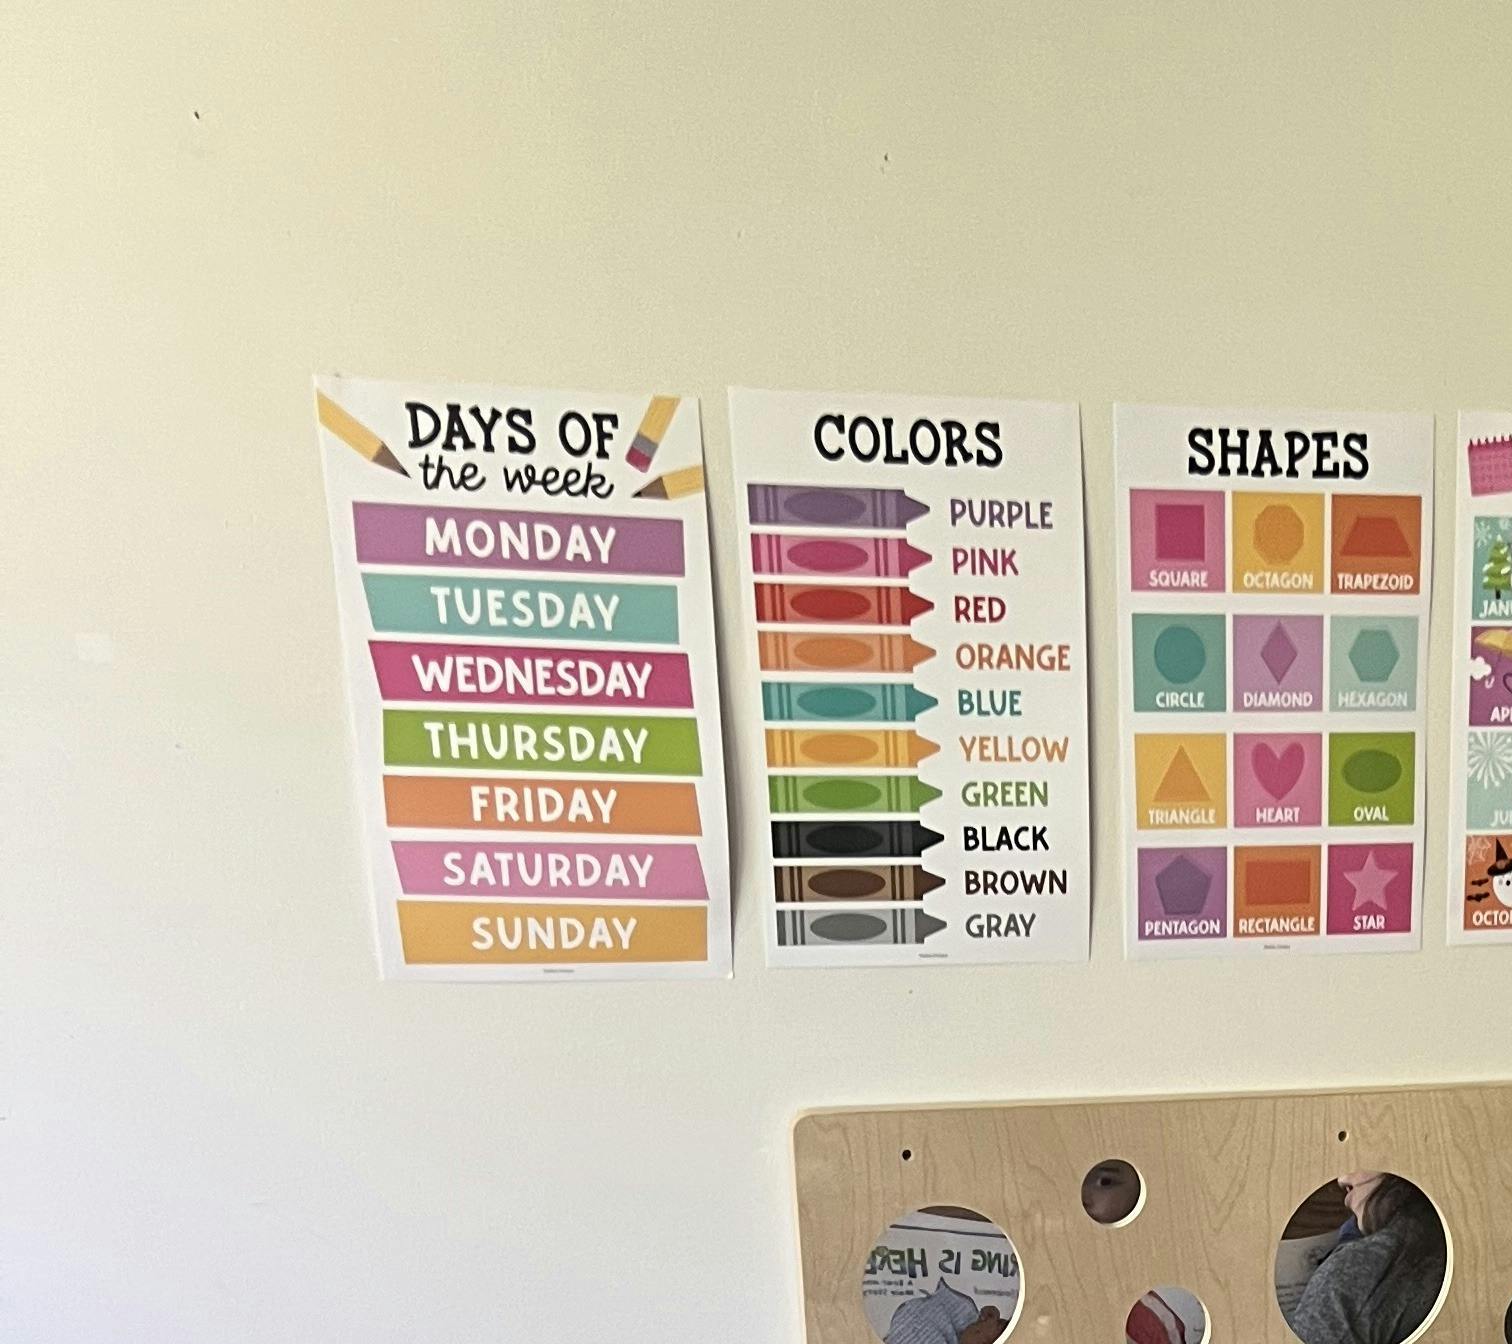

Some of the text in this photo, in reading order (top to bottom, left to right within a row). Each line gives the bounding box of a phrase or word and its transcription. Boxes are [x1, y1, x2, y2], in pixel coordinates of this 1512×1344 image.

[405, 402, 618, 459] DAYS OF
[814, 414, 1003, 468] COLORS
[1187, 428, 1369, 479] SHAPES
[419, 455, 614, 498] the week
[951, 499, 1053, 530] PURPLE
[425, 518, 616, 564] MONDAY
[952, 547, 1019, 576] PINK
[1149, 570, 1208, 588] SQUARE
[1243, 571, 1313, 590] OCTAGON
[1337, 573, 1414, 592] TRAPEZOID
[431, 586, 619, 632] TUESDAY
[954, 596, 1006, 624] RED
[956, 644, 1071, 672] ORANGE
[412, 654, 652, 699] WEDNESDAY
[958, 690, 1022, 717] BLUE
[1156, 692, 1205, 709] CIRCLE
[1243, 691, 1313, 708] DIAMOND
[1338, 691, 1407, 708] HEXAGON
[424, 722, 648, 764] THURSDAY
[959, 736, 1069, 763] YELLOW
[471, 786, 618, 824] FRIDAY
[961, 781, 1049, 808] GREEN
[1148, 808, 1216, 825] TRIANGLE
[1255, 807, 1299, 824] HEART
[1354, 805, 1389, 822] OVAL
[963, 826, 1049, 851] BLACK
[442, 852, 654, 888] SATURDAY
[965, 870, 1067, 896] BROWN
[472, 918, 638, 951] SUNDAY
[965, 913, 1036, 939] GRAY
[1144, 918, 1220, 936] PENTAGON
[1239, 916, 1314, 933] RECTANGLE
[1353, 915, 1385, 931] STAR
